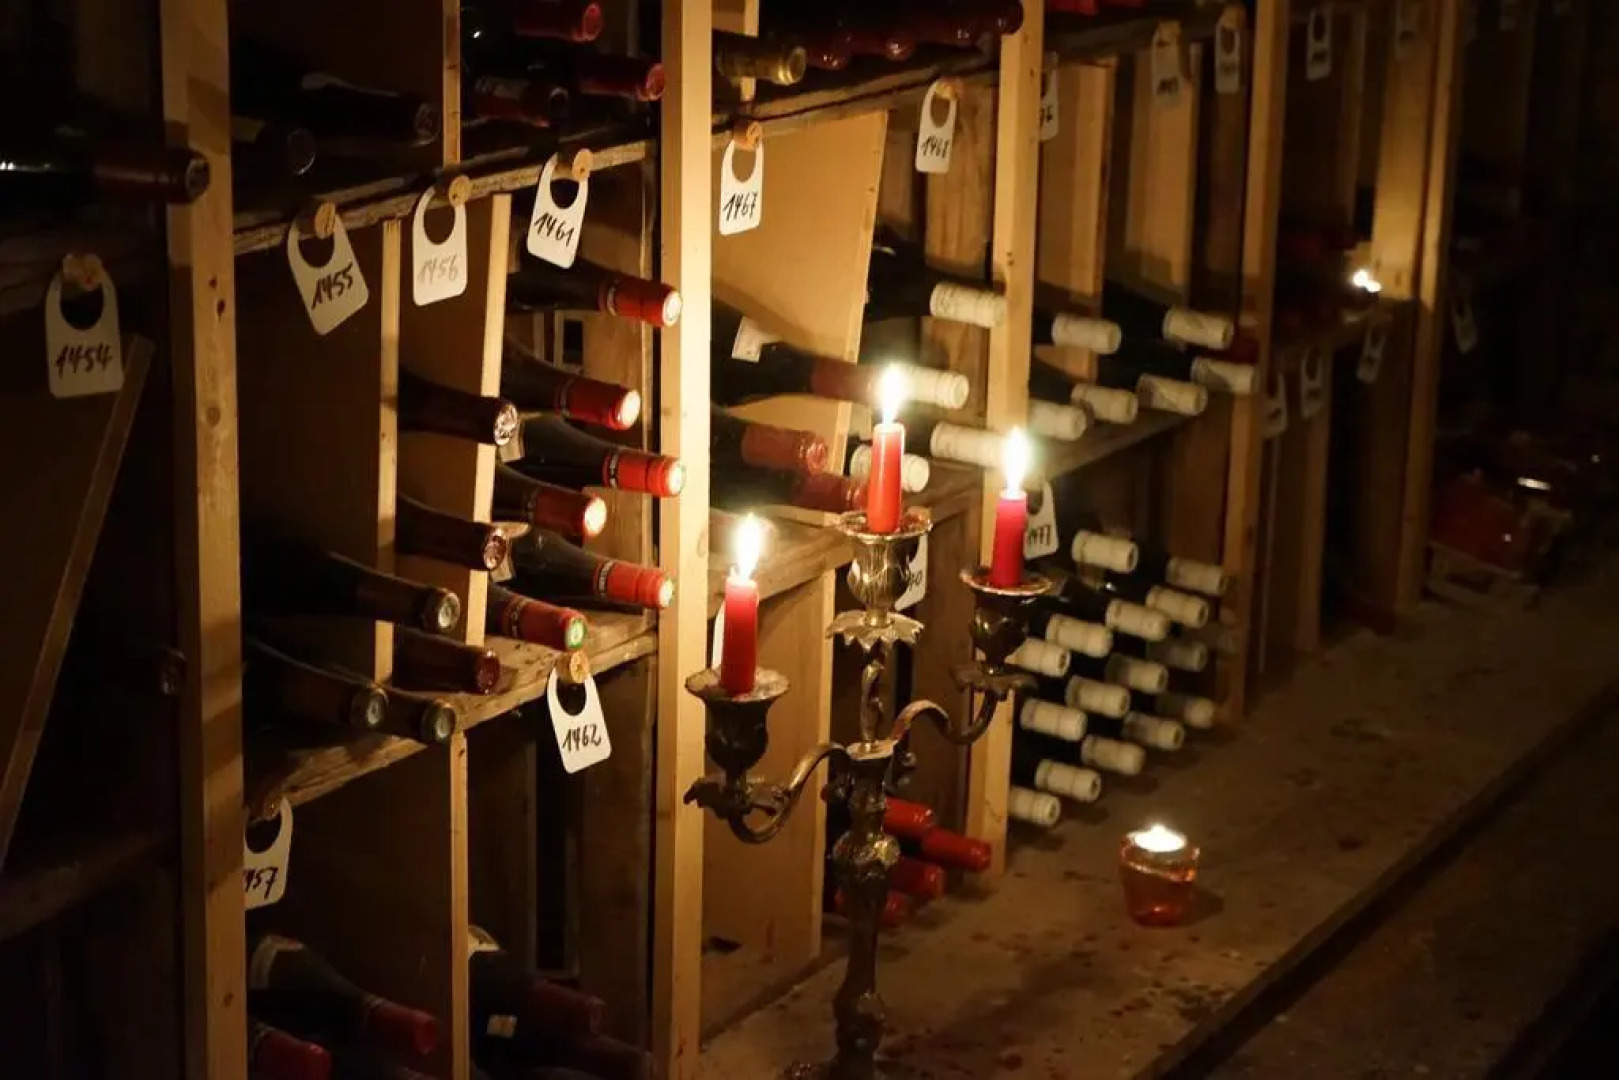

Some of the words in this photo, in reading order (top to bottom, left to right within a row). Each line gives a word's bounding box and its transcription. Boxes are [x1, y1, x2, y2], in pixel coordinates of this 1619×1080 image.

[722, 190, 758, 222] 1467
[533, 212, 574, 247] 1461
[310, 263, 355, 310] 1455
[416, 253, 460, 286] 1456
[55, 343, 113, 379] 1454
[561, 723, 602, 751] 1462
